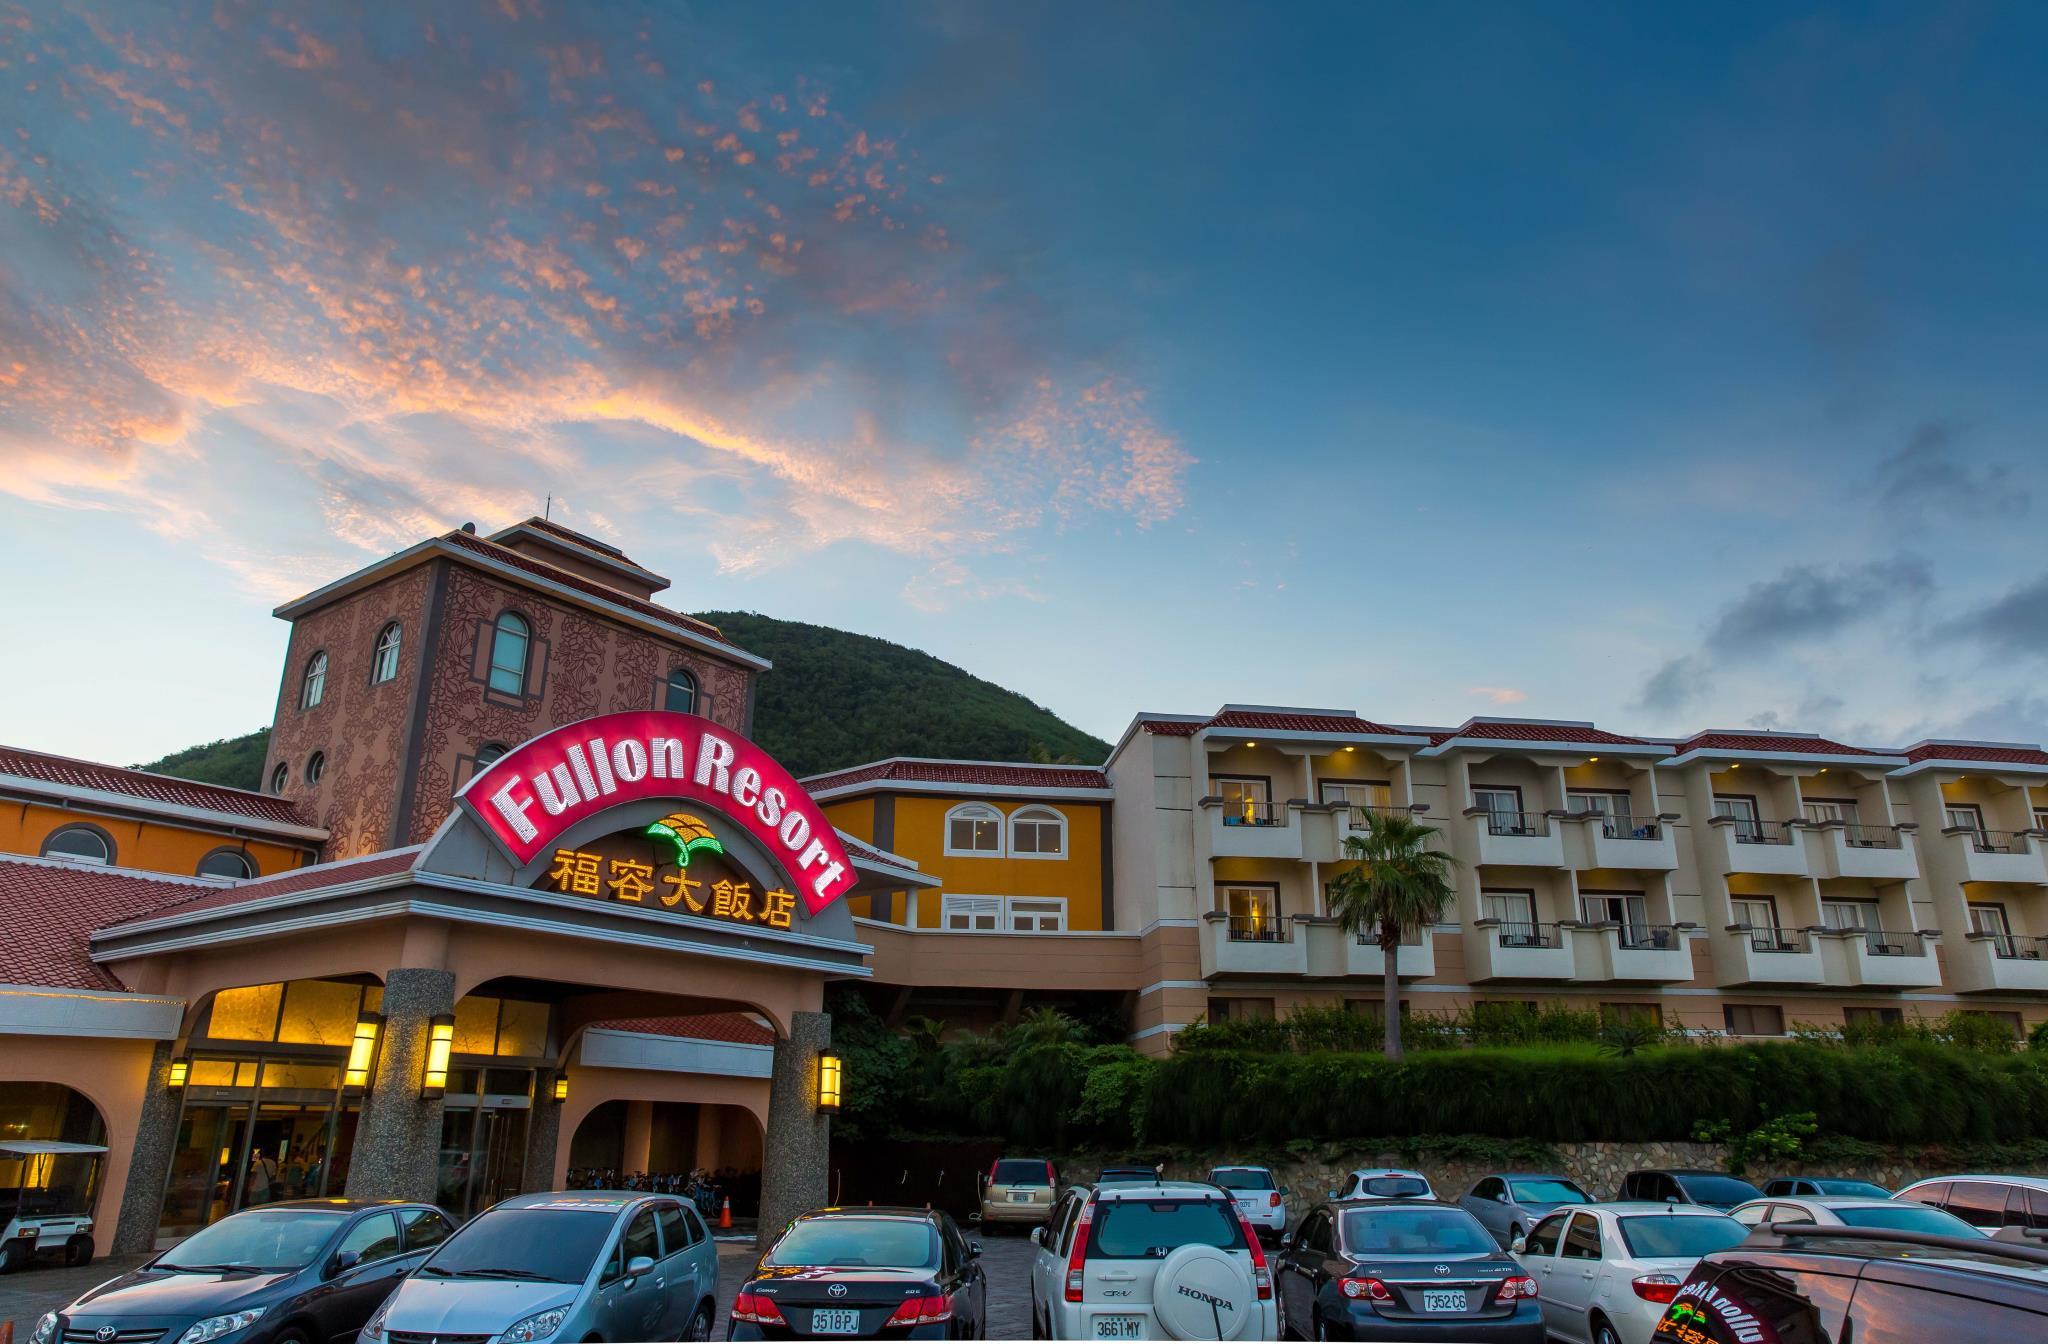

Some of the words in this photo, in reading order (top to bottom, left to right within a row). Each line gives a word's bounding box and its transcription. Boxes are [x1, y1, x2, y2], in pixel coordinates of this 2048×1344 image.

[490, 736, 684, 845] Fullon
[693, 732, 846, 898] Resort
[550, 848, 797, 929] 福容大飯店
[1178, 1285, 1234, 1311] HONDA
